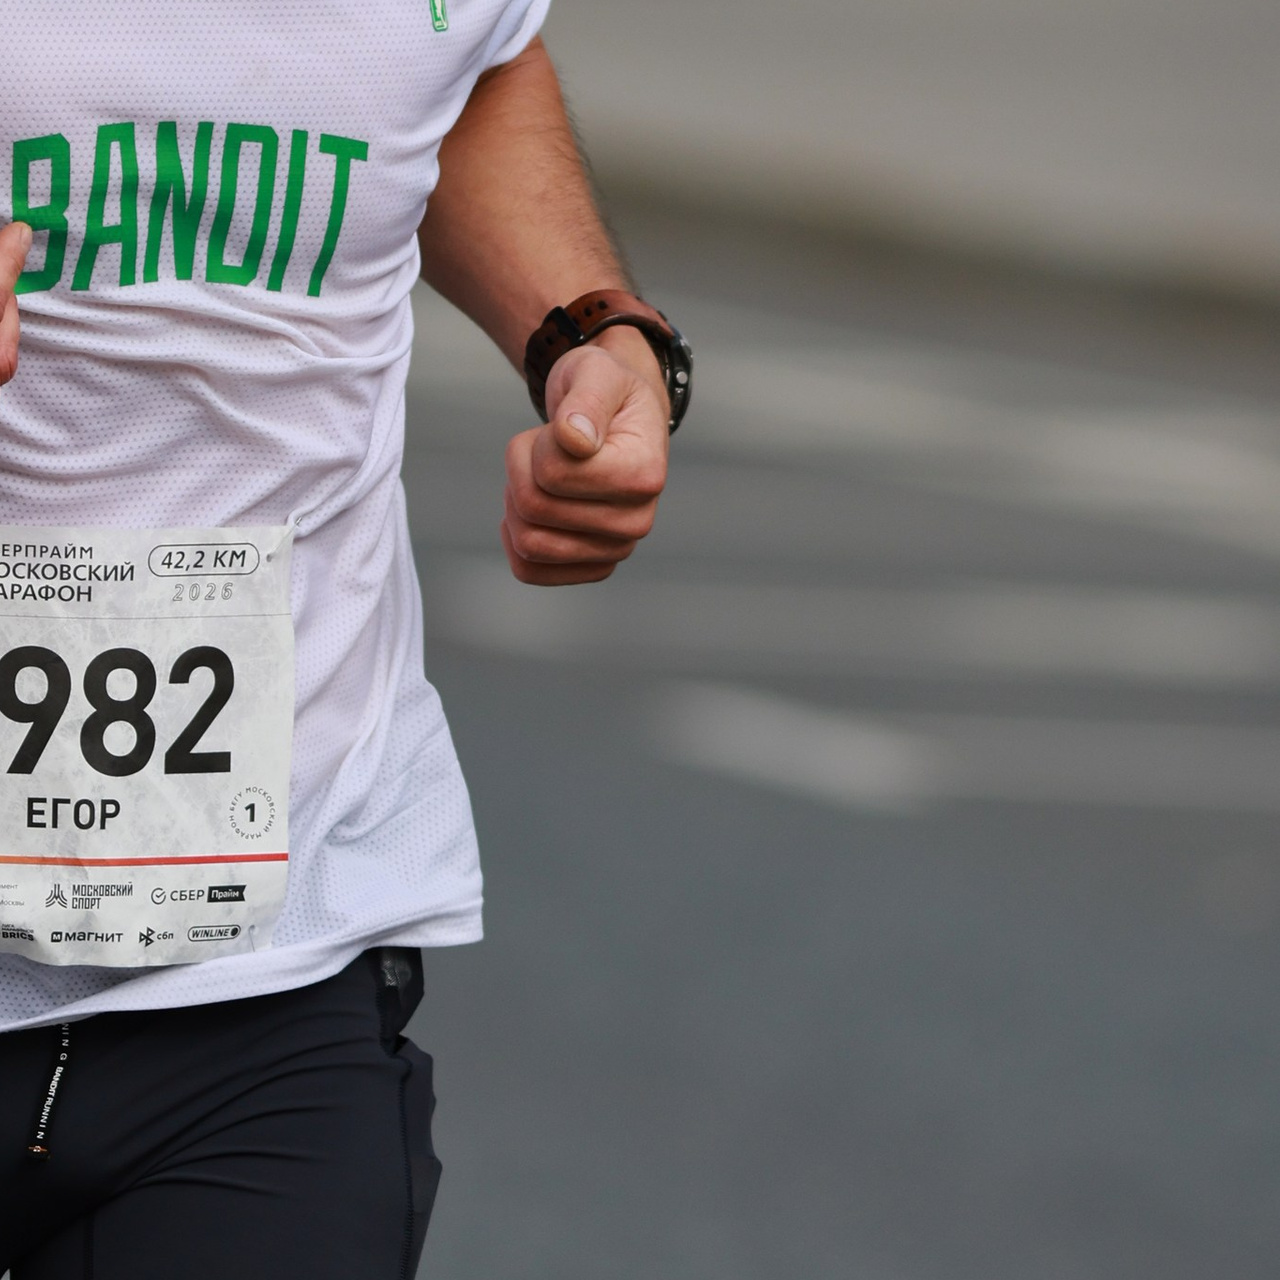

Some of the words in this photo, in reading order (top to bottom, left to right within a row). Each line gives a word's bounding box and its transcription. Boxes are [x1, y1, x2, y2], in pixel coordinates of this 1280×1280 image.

[12, 121, 370, 297] BANDIT
[161, 550, 206, 571] 42,2
[172, 582, 234, 602] 2026
[26, 797, 121, 830] ЕГОР
[244, 803, 255, 822] 1
[71, 881, 134, 897] МОСКОВСКИЙ
[170, 889, 205, 902] СБЕР
[211, 889, 239, 899] Прайм
[71, 897, 101, 910] СПОРТ
[2, 931, 35, 941] BRICS
[191, 928, 230, 939] WINLINE
[48, 1066, 64, 1097] BANDIT
